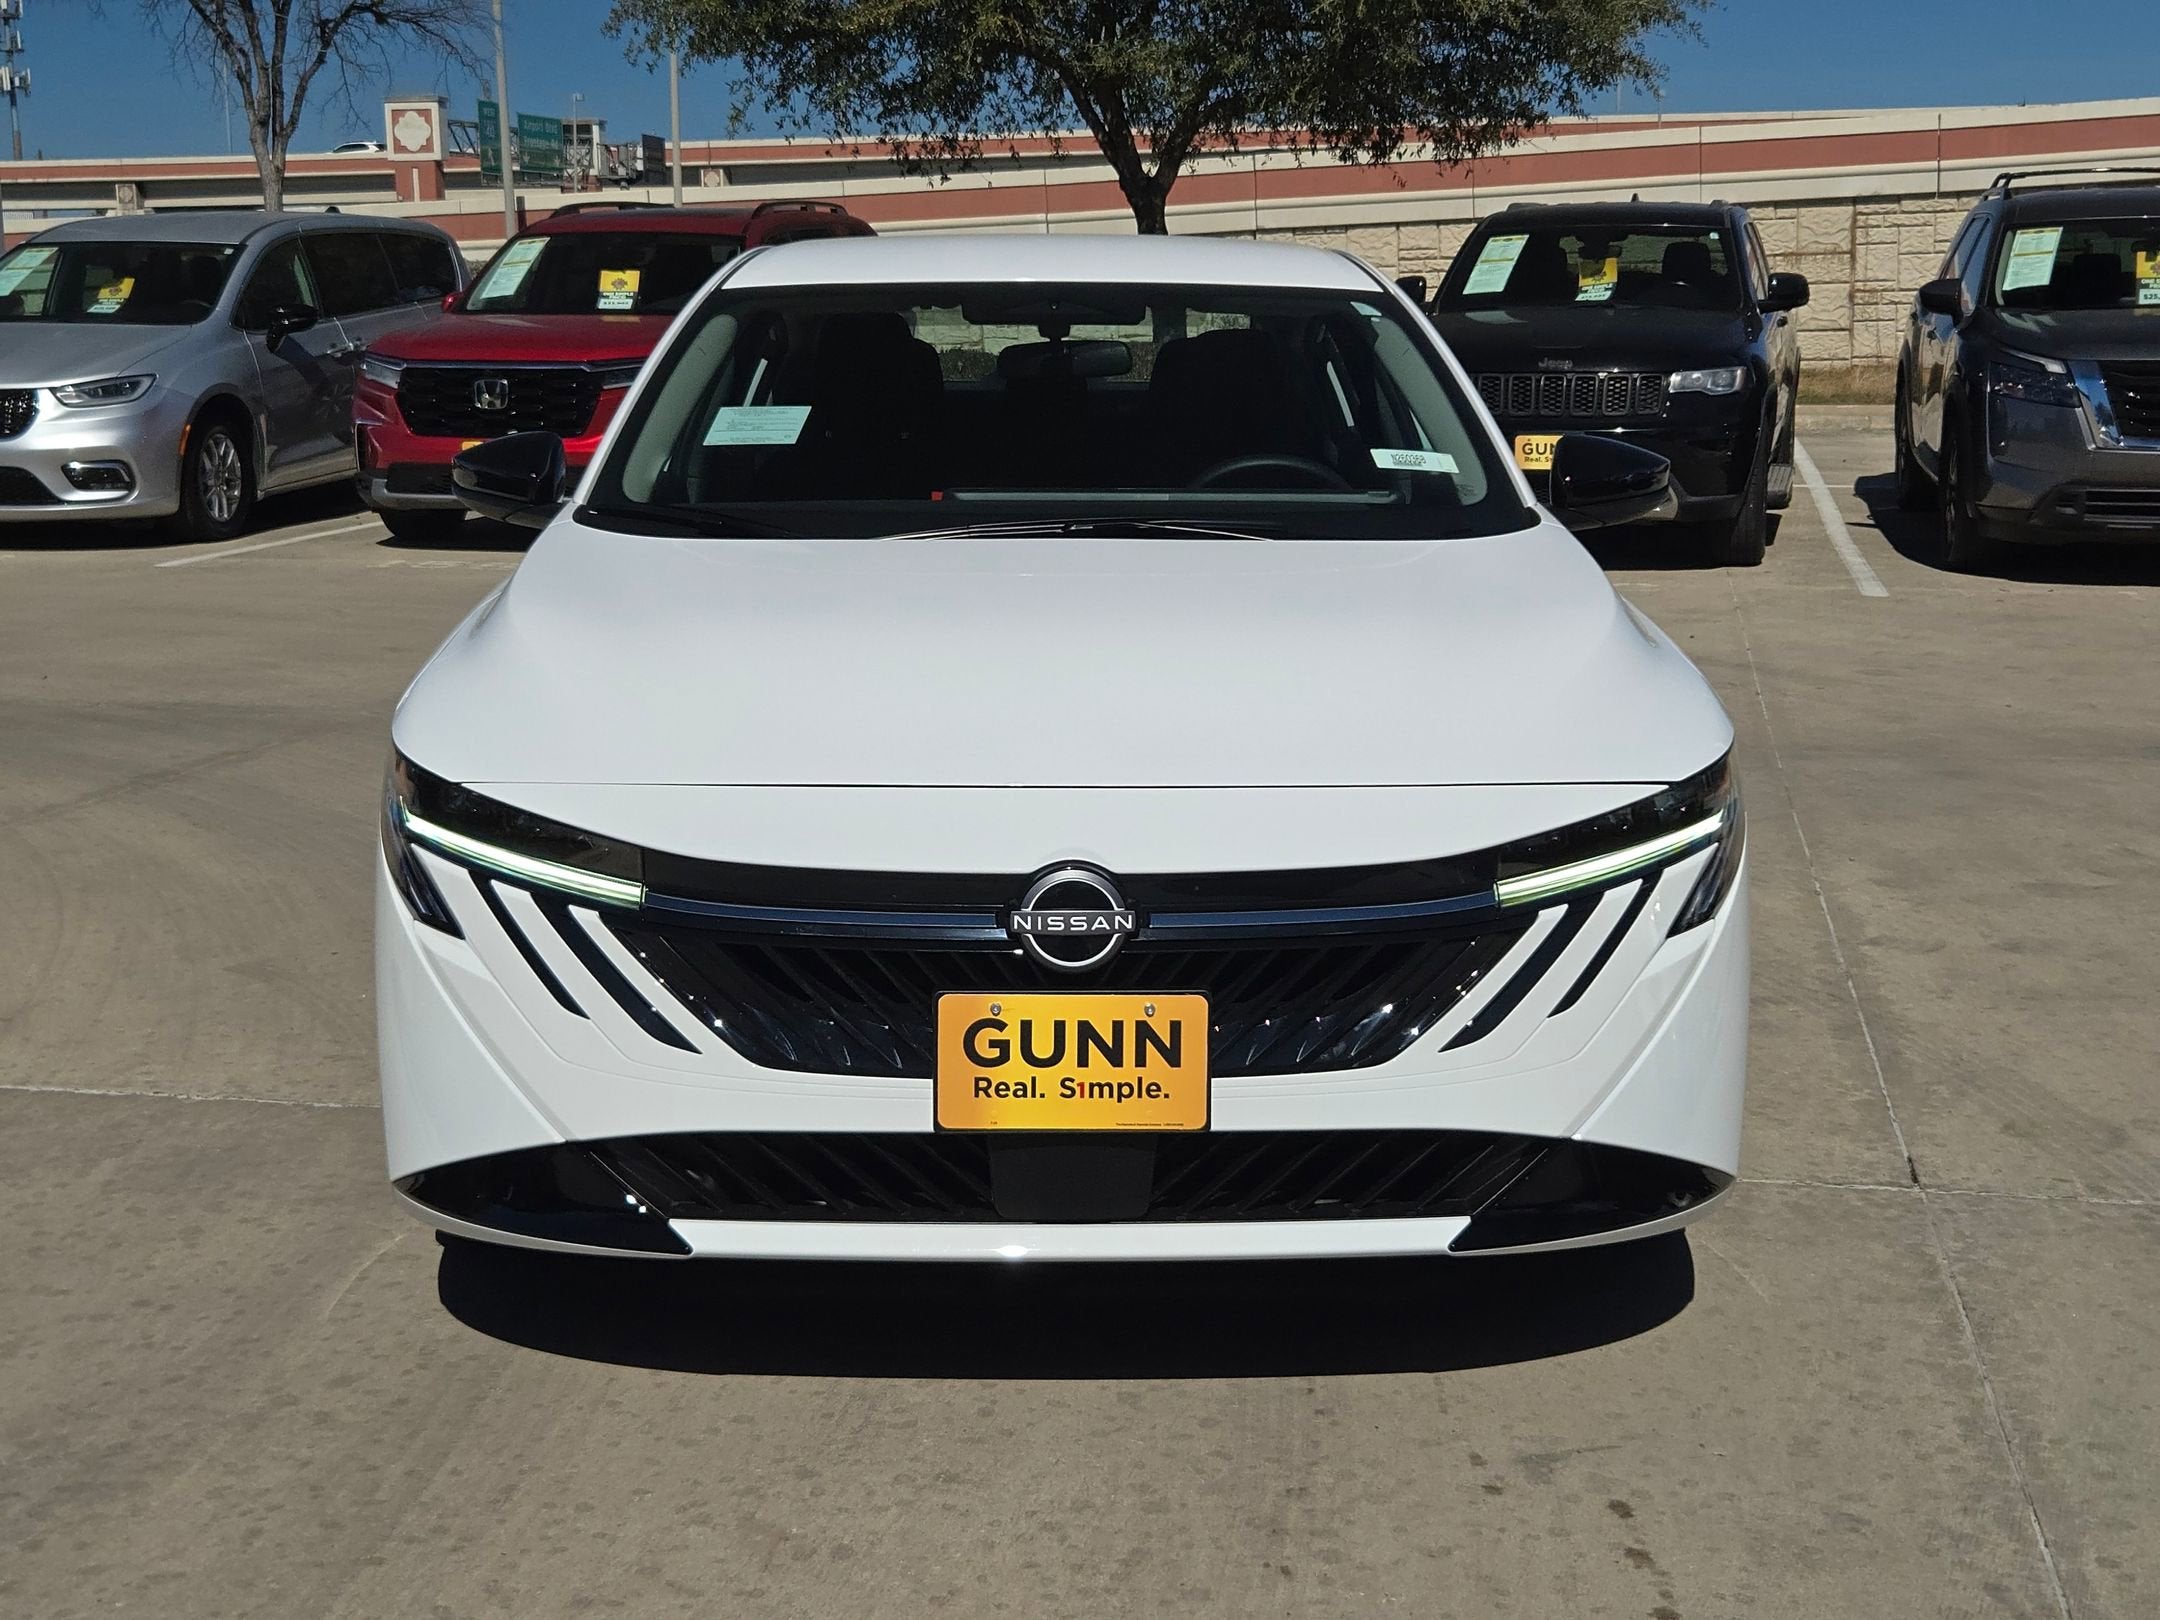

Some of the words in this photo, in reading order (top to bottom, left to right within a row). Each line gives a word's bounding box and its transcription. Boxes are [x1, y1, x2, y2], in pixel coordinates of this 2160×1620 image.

[1012, 914, 1134, 932] NISSAN
[962, 1017, 1182, 1068] GUNN
[973, 1076, 1046, 1099] Real.
[1059, 1076, 1170, 1104] S1mple.
